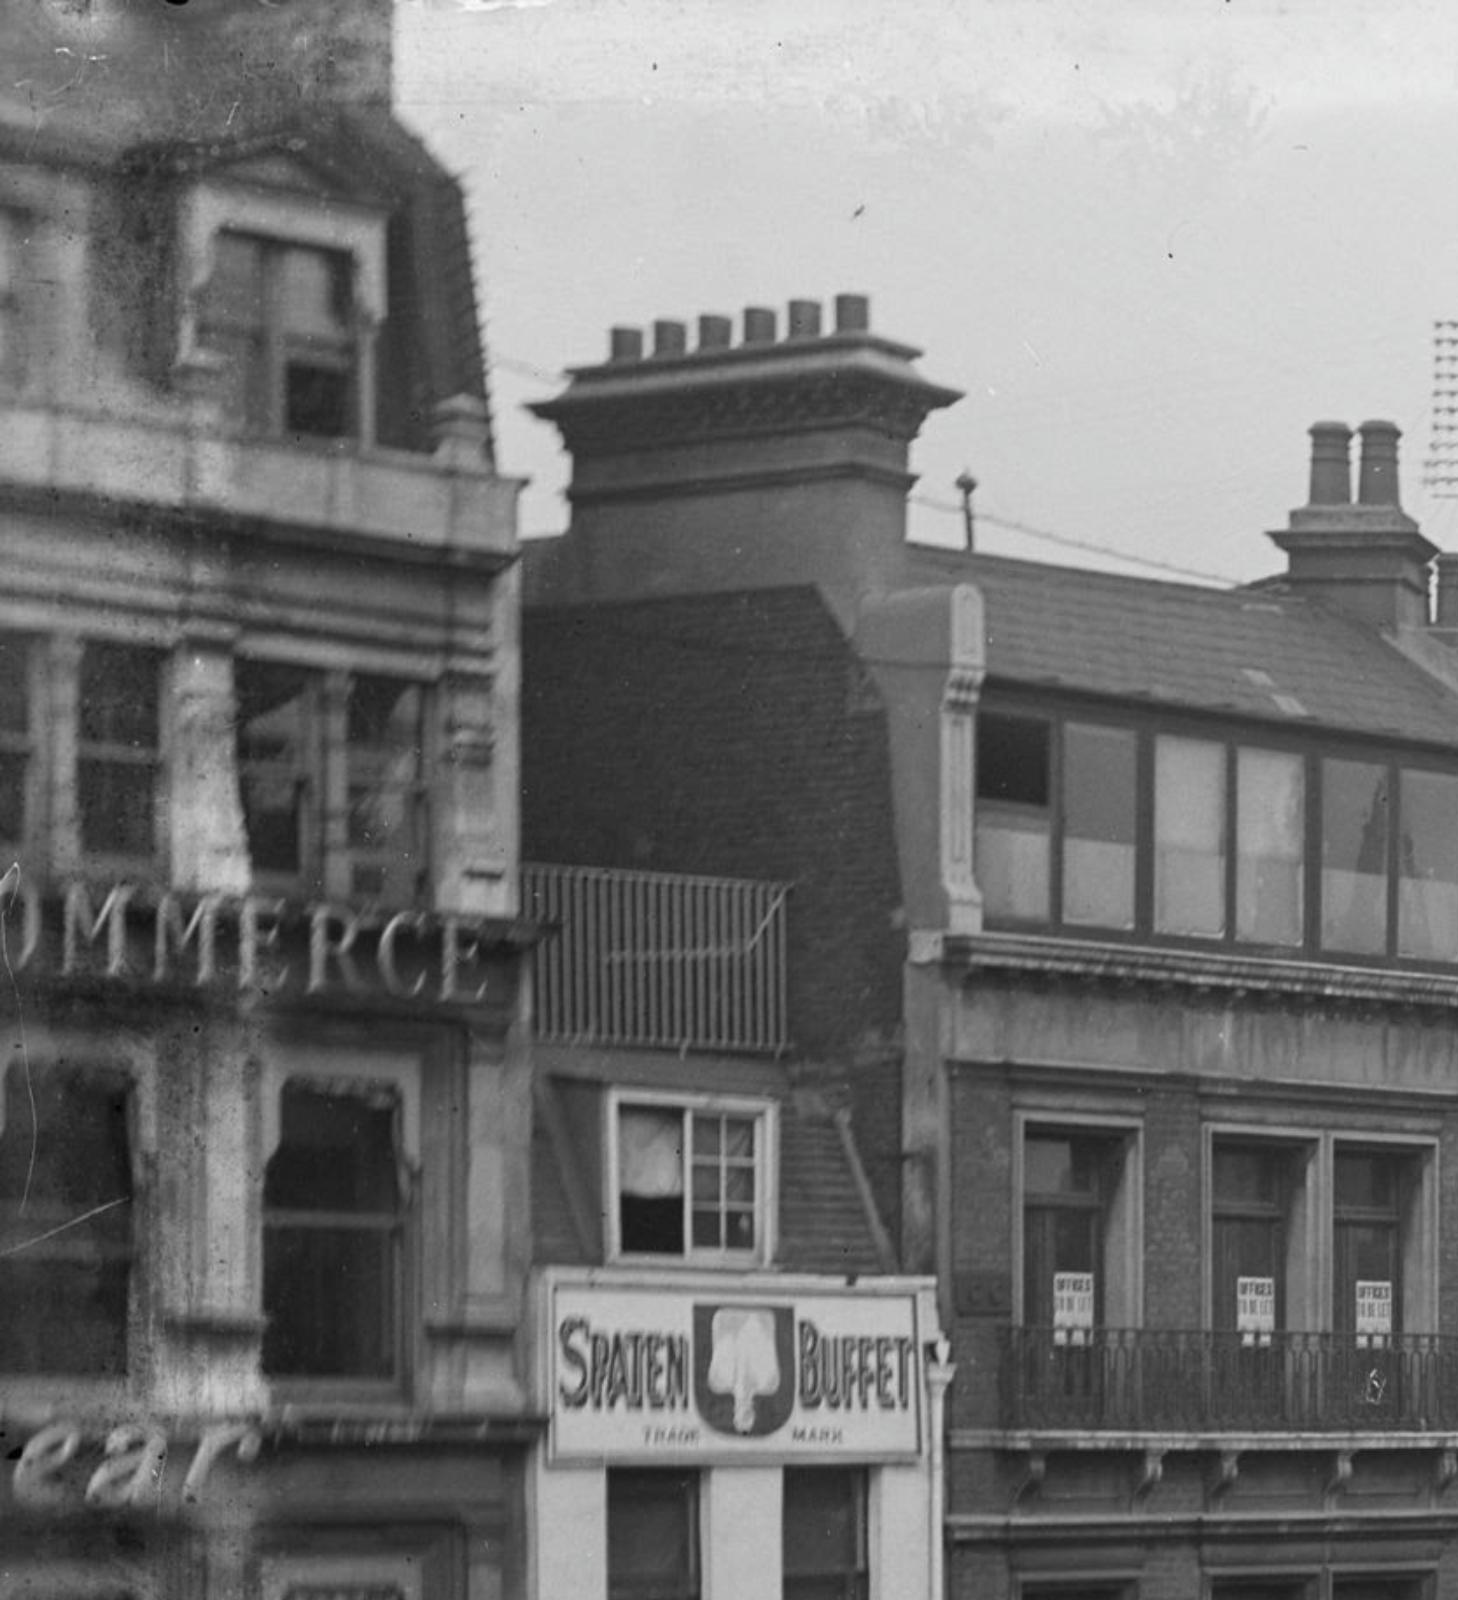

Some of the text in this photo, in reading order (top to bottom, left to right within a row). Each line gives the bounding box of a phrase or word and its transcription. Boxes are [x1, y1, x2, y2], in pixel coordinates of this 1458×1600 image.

[559, 1317, 912, 1411] SPATEN BUFFET
[642, 1426, 843, 1445] TRADE MARK
